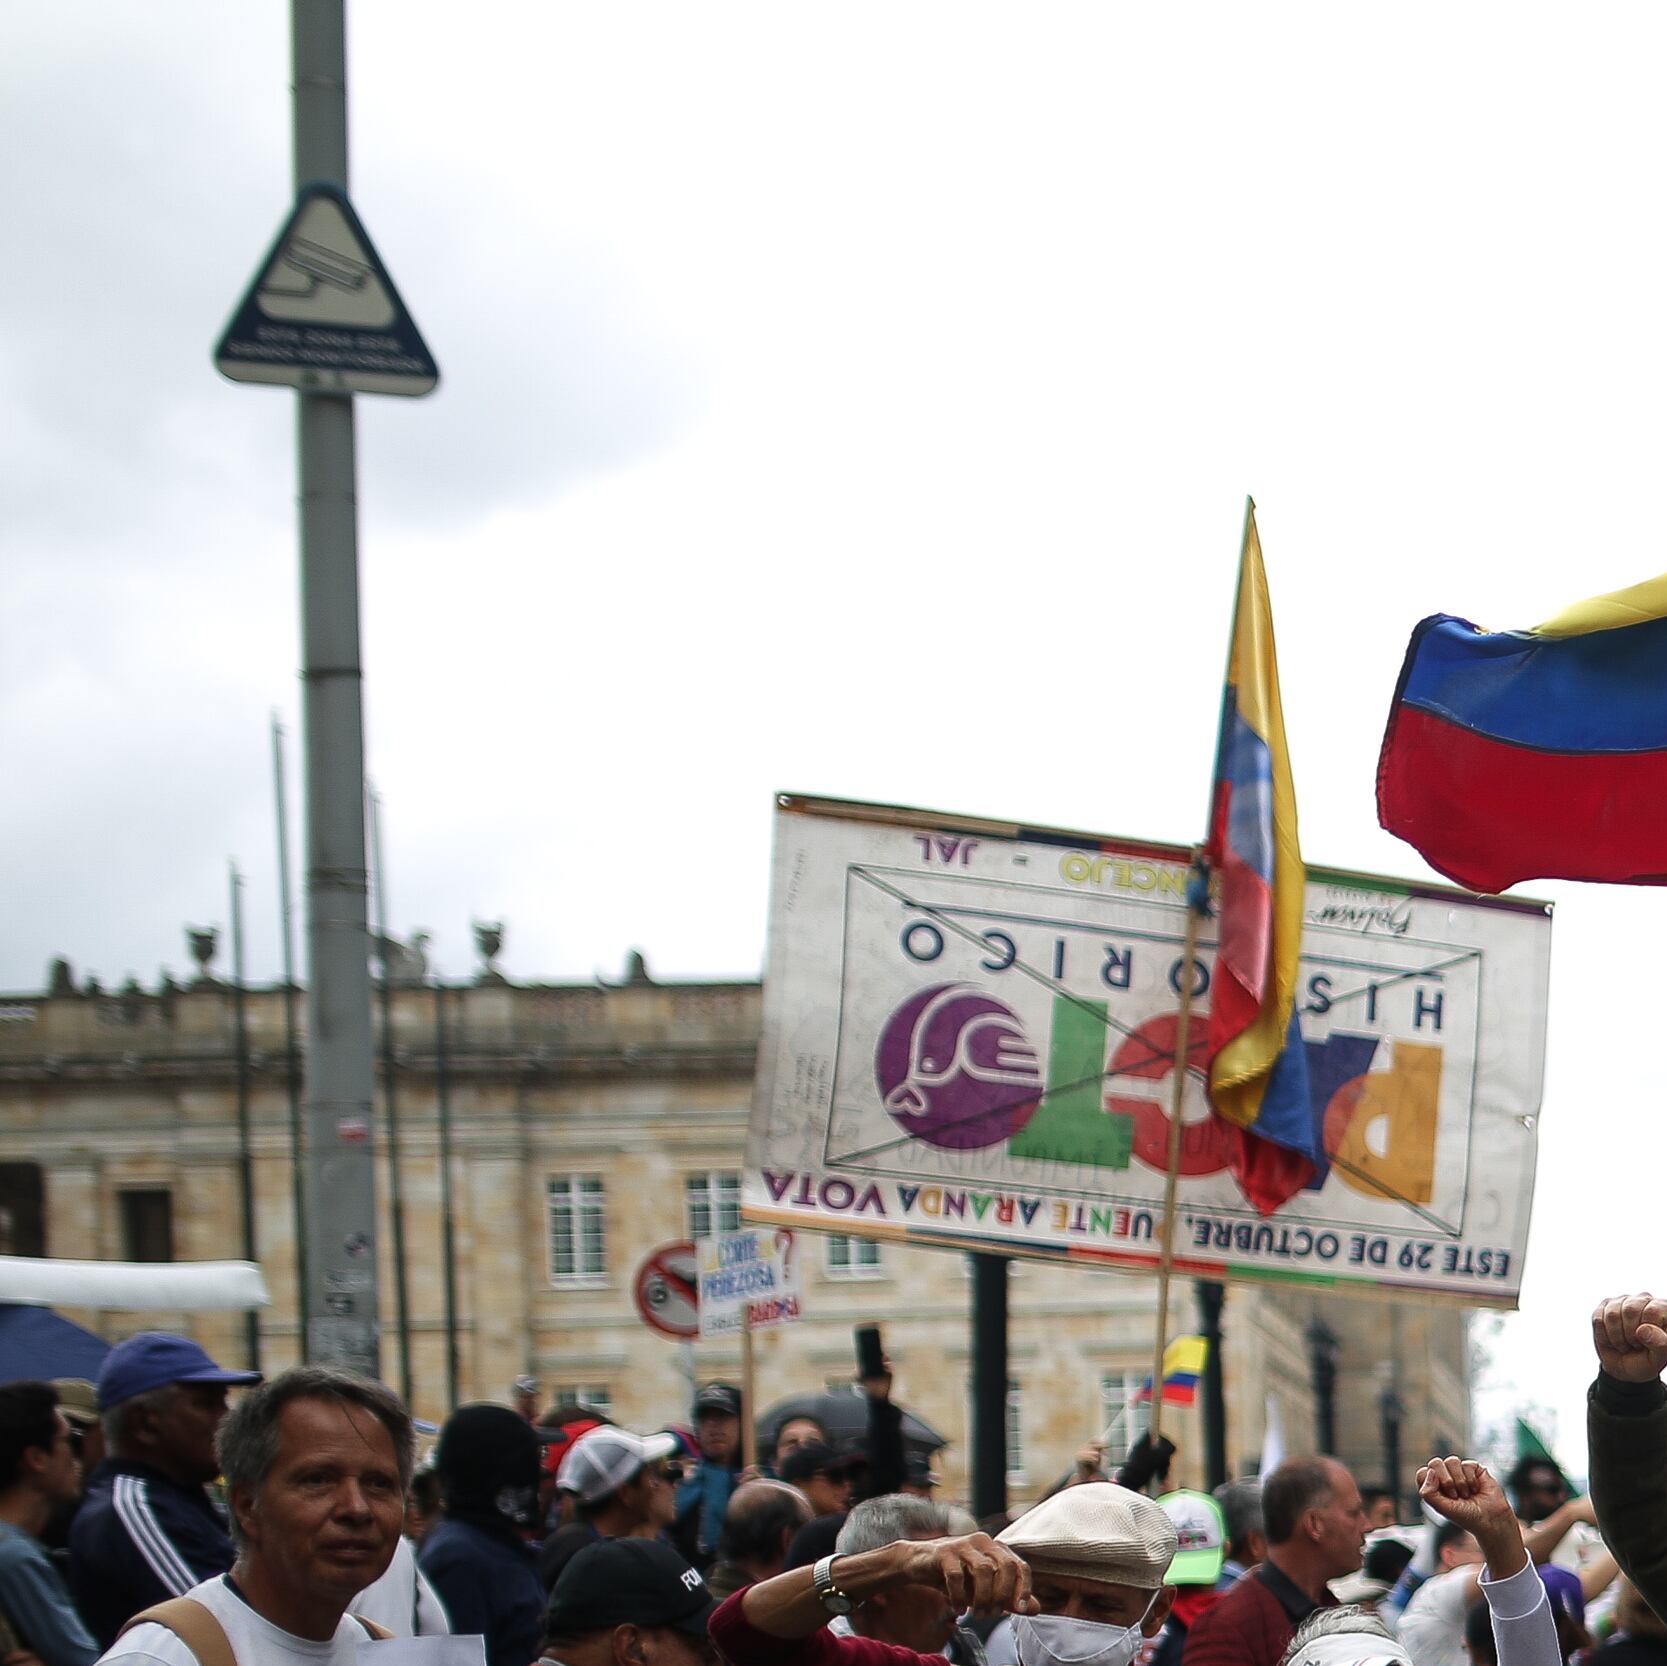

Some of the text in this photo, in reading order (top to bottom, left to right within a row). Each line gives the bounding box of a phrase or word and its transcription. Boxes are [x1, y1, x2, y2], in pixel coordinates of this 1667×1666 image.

[914, 834, 980, 867] JAL
[900, 919, 1444, 1030] HISORICO
[762, 1169, 887, 1216] VOTA
[897, 1183, 1041, 1225] ARANDA
[1050, 1202, 1165, 1243] UENTE
[1348, 1236, 1387, 1264] DE
[1399, 1240, 1432, 1269] 29
[1441, 1244, 1511, 1278] ESTE
